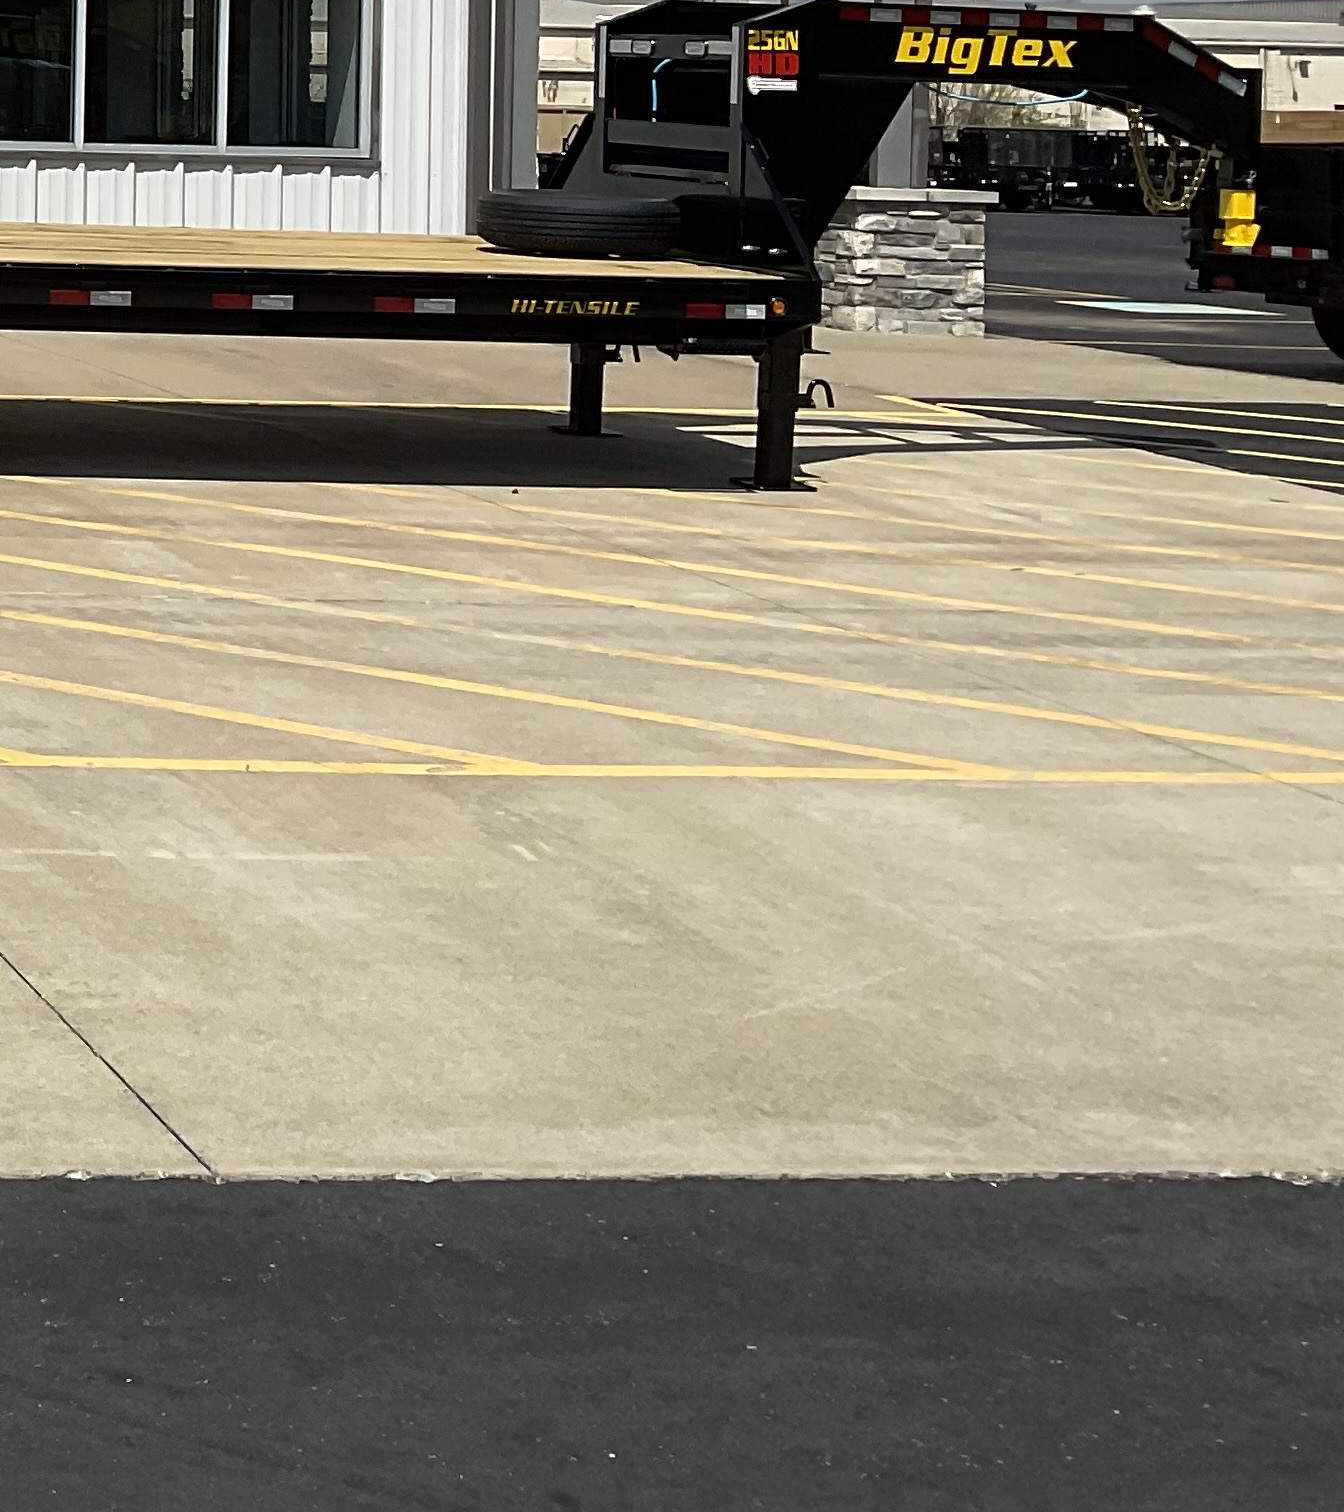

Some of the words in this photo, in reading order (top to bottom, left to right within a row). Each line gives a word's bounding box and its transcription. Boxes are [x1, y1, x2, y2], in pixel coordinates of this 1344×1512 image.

[747, 29, 799, 51] 25GN
[894, 25, 1078, 75] BigTex
[748, 52, 799, 76] HD
[510, 299, 641, 316] HI-TENSILE
